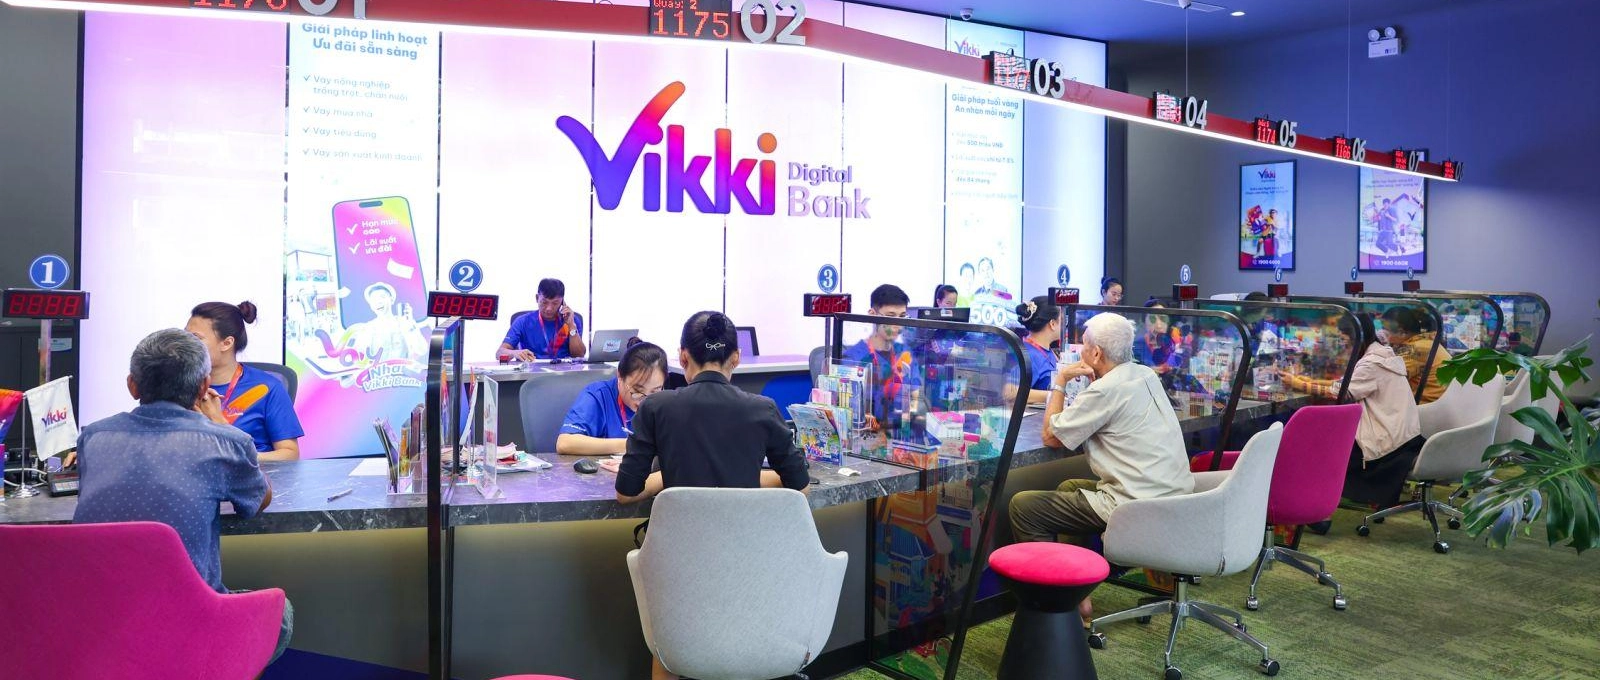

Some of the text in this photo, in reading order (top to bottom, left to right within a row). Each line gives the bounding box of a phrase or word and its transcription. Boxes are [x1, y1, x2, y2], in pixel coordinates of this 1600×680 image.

[690, 0, 697, 9] 2
[653, 9, 729, 38] 1175
[740, 0, 806, 45] 02
[334, 26, 368, 40] pháp
[372, 29, 395, 41] linh
[398, 32, 428, 47] hoạt
[313, 37, 417, 60] Ưu đãi sẵn sàng
[314, 75, 331, 84] Vay
[1034, 58, 1065, 98] 03
[1186, 96, 1208, 130] 04
[1280, 120, 1298, 148] 05
[556, 81, 777, 215] Vikki
[1352, 138, 1366, 162] 06
[1409, 150, 1422, 172] 07
[788, 161, 853, 186] Digital
[788, 186, 871, 219] Bank
[41, 260, 56, 284] 1
[458, 265, 475, 287] 2
[823, 269, 834, 288] 3
[1060, 268, 1067, 284] 4
[1183, 268, 1189, 282] 5
[970, 304, 1007, 326] 500
[364, 378, 393, 391] Vikki
[42, 406, 67, 428] Vikki
